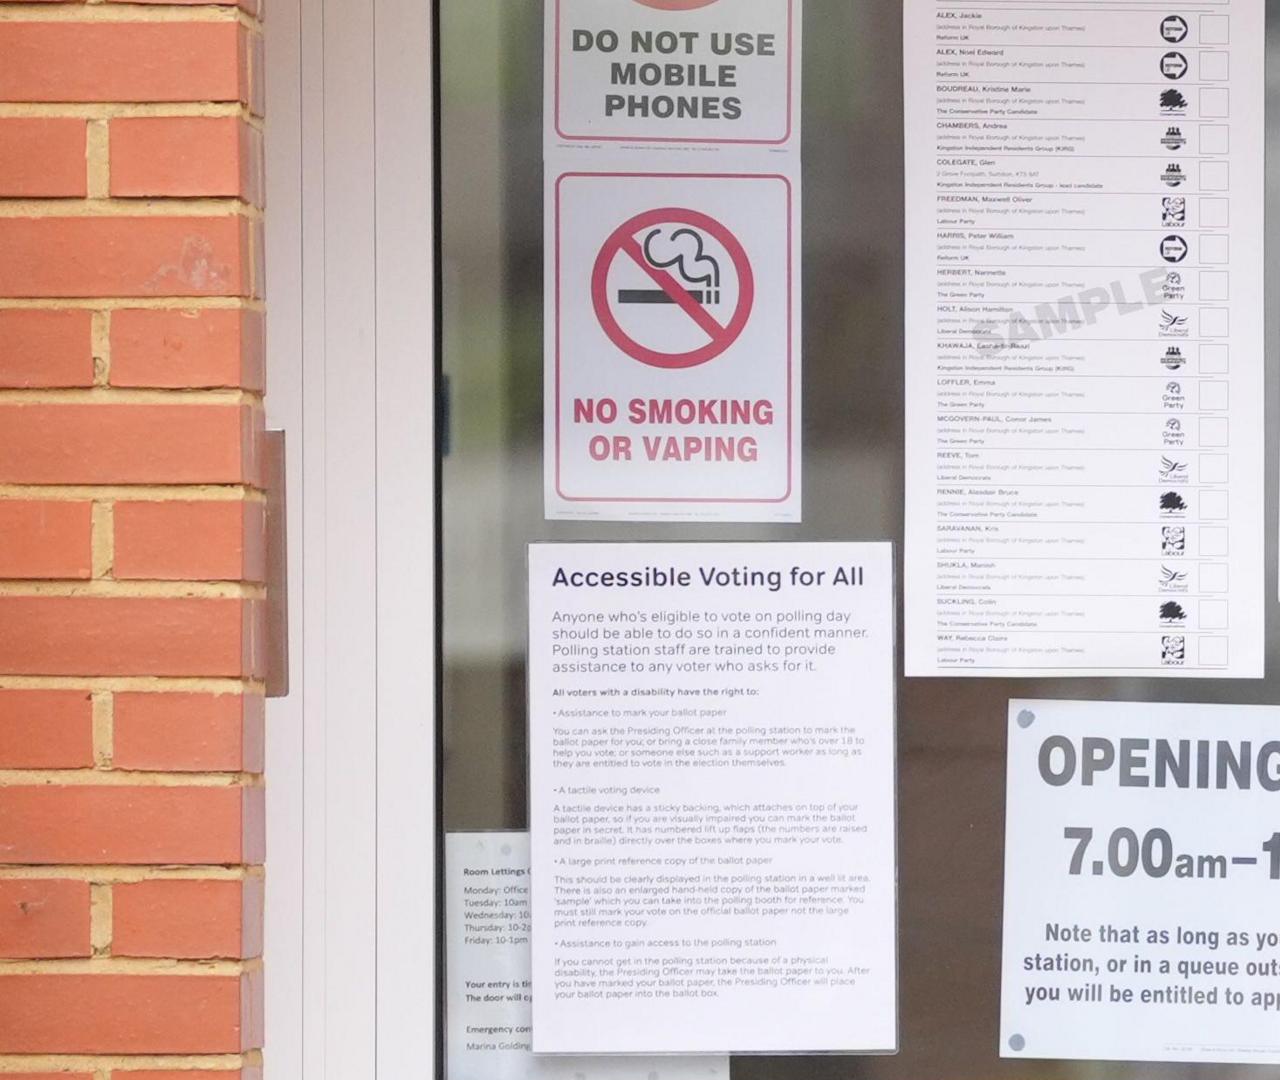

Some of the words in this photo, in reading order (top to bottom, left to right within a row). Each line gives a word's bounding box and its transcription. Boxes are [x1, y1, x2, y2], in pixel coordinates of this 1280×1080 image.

[572, 28, 619, 53] DO
[630, 30, 699, 54] NOT
[710, 32, 775, 56] USE
[610, 62, 736, 87] MOBILE
[605, 94, 741, 120] PHONES
[972, 266, 1174, 358] SAMPLE
[573, 397, 617, 424] NO
[628, 397, 773, 425] SMOKING
[588, 434, 631, 461] OR
[641, 435, 757, 462] VAPING
[552, 566, 691, 587] Accessible
[698, 565, 781, 592] Voting
[789, 566, 825, 586] for
[832, 566, 863, 586] All
[551, 610, 604, 626] Anyone
[607, 610, 647, 623] who's
[650, 609, 700, 626] eligible
[704, 611, 718, 622] to
[721, 611, 751, 622] vote
[754, 612, 772, 622] on
[776, 609, 822, 625] polling
[826, 610, 851, 624] day
[551, 627, 599, 640] should
[602, 627, 620, 639] be
[623, 626, 654, 639] able
[657, 627, 671, 639] to
[674, 627, 693, 639] do
[696, 628, 713, 639] so
[716, 627, 728, 638] in
[732, 629, 740, 639] a
[744, 626, 810, 639] confident
[813, 628, 868, 638] manner.
[552, 643, 598, 659] Polling
[602, 643, 650, 656] station
[654, 642, 685, 656] staff
[688, 645, 710, 655] are
[714, 643, 763, 655] trained
[766, 644, 780, 655] to
[784, 643, 836, 657] provide
[552, 660, 627, 673] assistance
[630, 660, 644, 672] to
[648, 662, 673, 674] any
[675, 661, 711, 672] voter
[714, 659, 743, 672] who
[747, 659, 779, 672] asks
[783, 659, 801, 671] for
[805, 659, 815, 671] it.
[552, 688, 565, 697] All
[566, 688, 597, 697] voters
[599, 688, 620, 696] with
[630, 687, 675, 697] disability
[677, 688, 700, 696] have
[702, 687, 719, 696] the
[721, 687, 744, 697] right
[746, 688, 759, 696] to:
[1045, 922, 1092, 942] Note
[1098, 924, 1140, 944] that
[1146, 929, 1169, 944] as
[1176, 925, 1219, 950] long
[1226, 931, 1249, 946] as
[1023, 952, 1099, 976] station,
[1106, 958, 1127, 973] or
[1133, 954, 1151, 973] in
[1158, 959, 1170, 974] a
[1177, 960, 1239, 979] queue
[1024, 986, 1060, 1006] you
[1067, 983, 1102, 1002] will
[1109, 984, 1133, 1003] be
[1140, 985, 1217, 1005] entitled
[1224, 987, 1244, 1005] to
